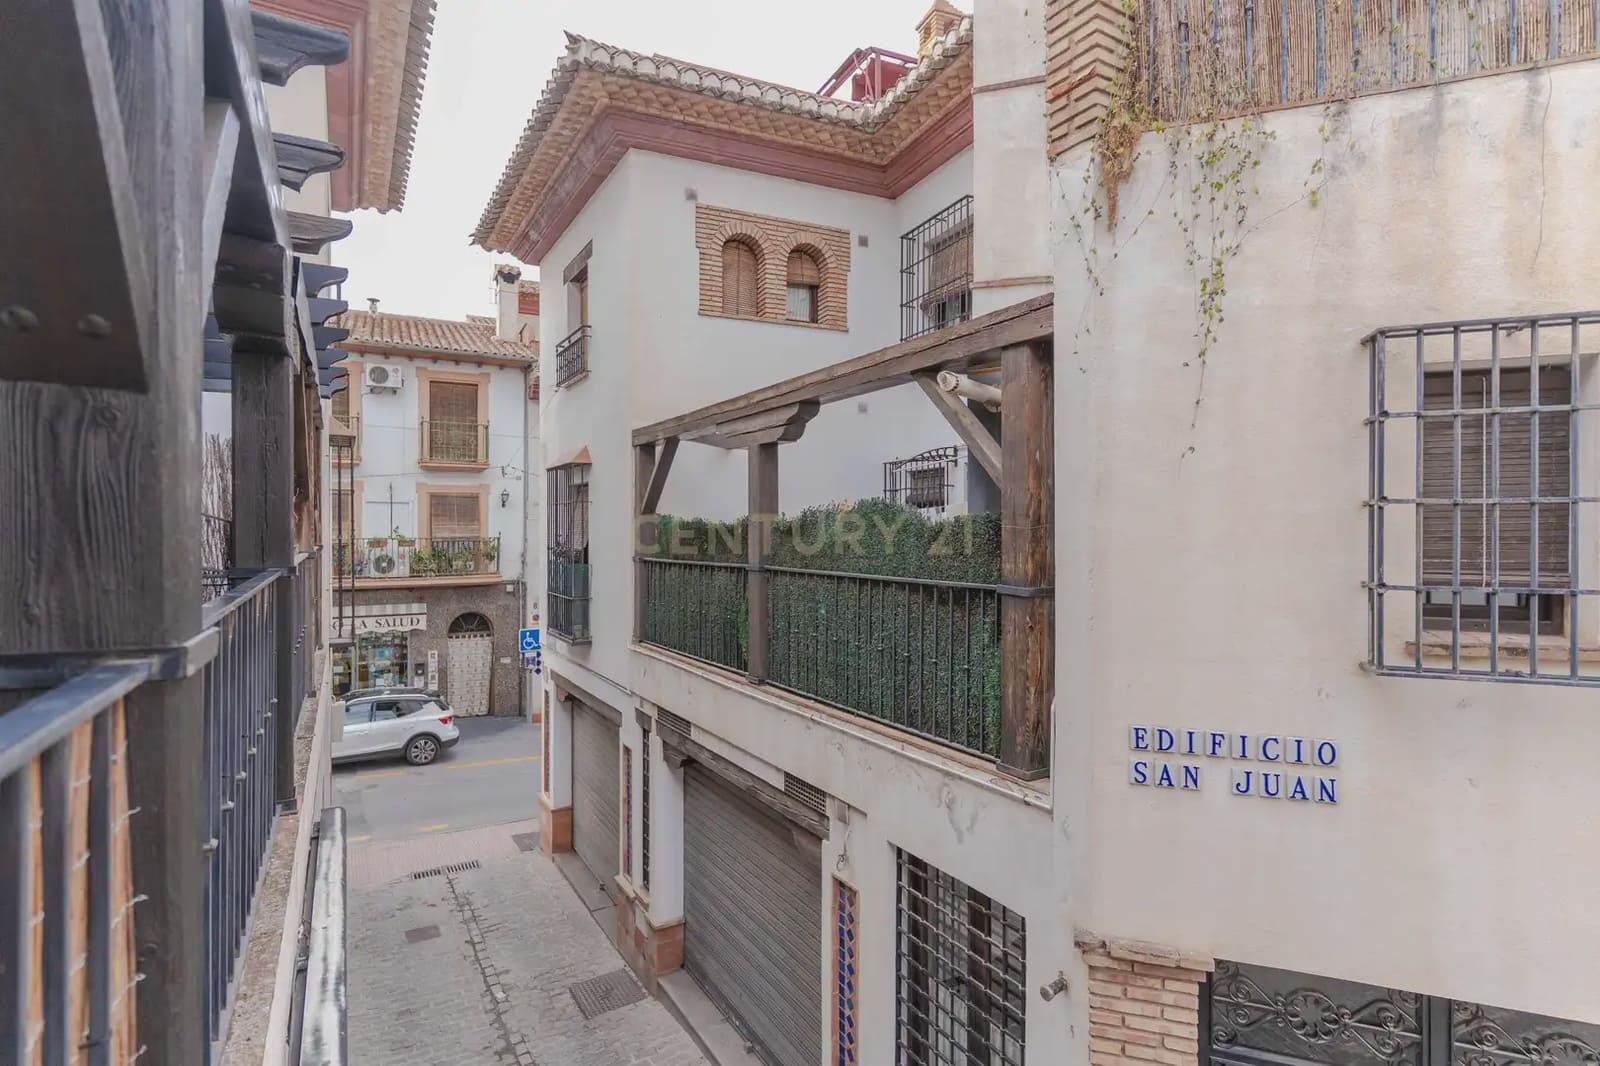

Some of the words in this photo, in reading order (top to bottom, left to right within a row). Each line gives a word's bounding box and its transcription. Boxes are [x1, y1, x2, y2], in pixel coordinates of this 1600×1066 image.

[375, 616, 419, 628] SALUD
[1133, 727, 1337, 765] EDIFICIO
[1134, 762, 1200, 788] SAN
[1235, 771, 1337, 803] JUAN
